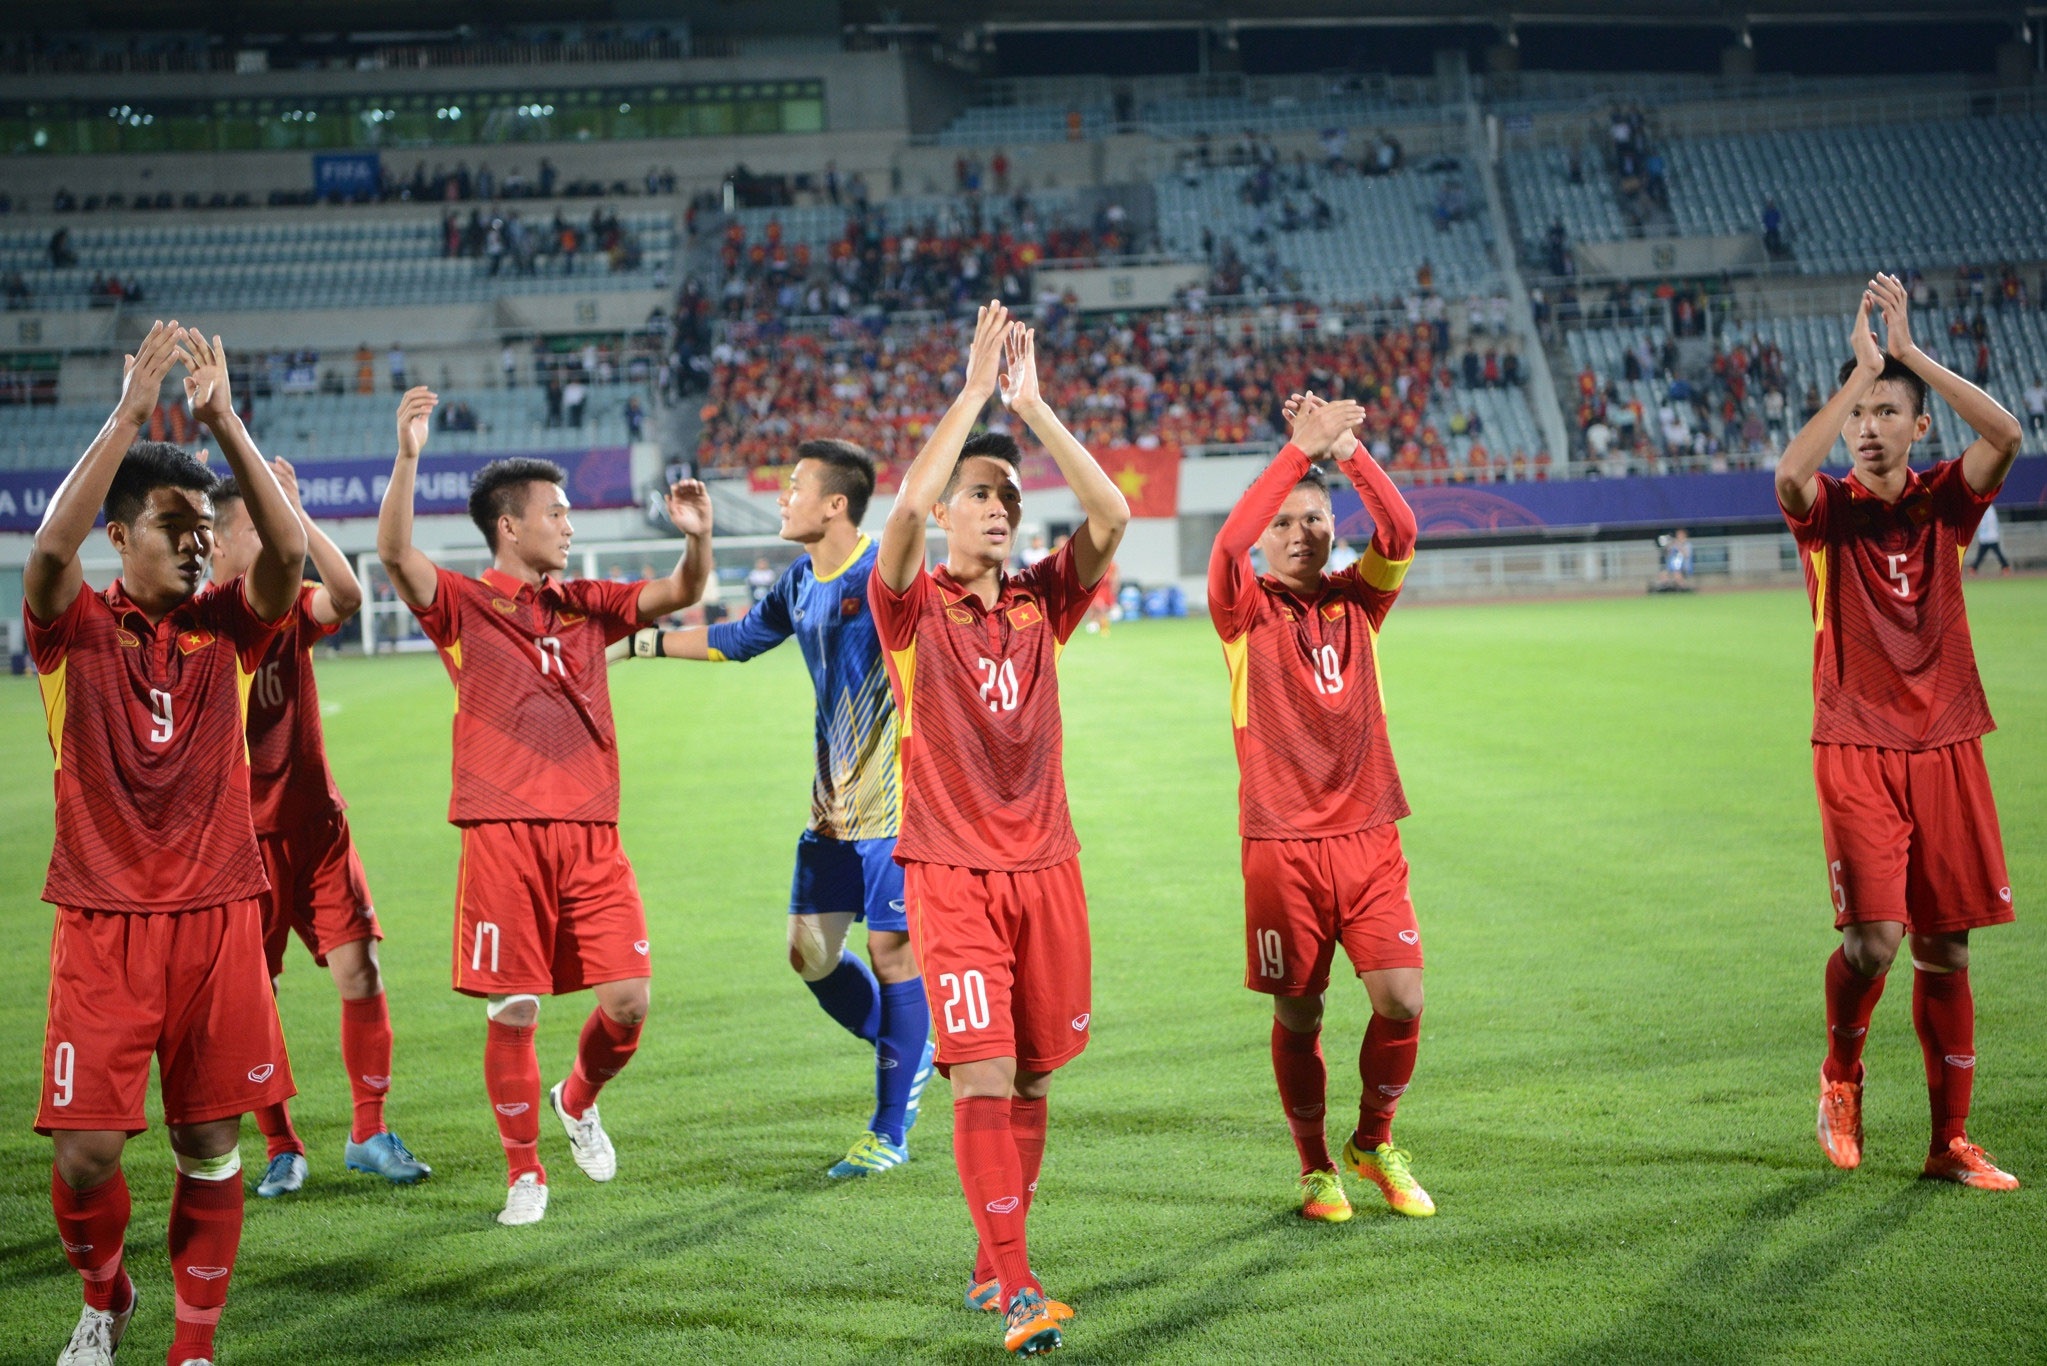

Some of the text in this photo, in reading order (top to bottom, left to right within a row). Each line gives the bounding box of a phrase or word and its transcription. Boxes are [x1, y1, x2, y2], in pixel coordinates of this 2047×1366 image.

[299, 475, 367, 506] OREA
[1888, 553, 1910, 598] 5
[534, 636, 566, 677] 17
[818, 623, 827, 669] 1
[1311, 645, 1344, 694] 19
[257, 660, 284, 709] 16
[978, 657, 1019, 712] 20
[150, 688, 174, 743] 9
[1831, 860, 1846, 912] 5
[472, 920, 500, 973] 17
[1256, 927, 1284, 979] 19
[939, 969, 990, 1033] 20
[53, 1041, 75, 1107] 9
